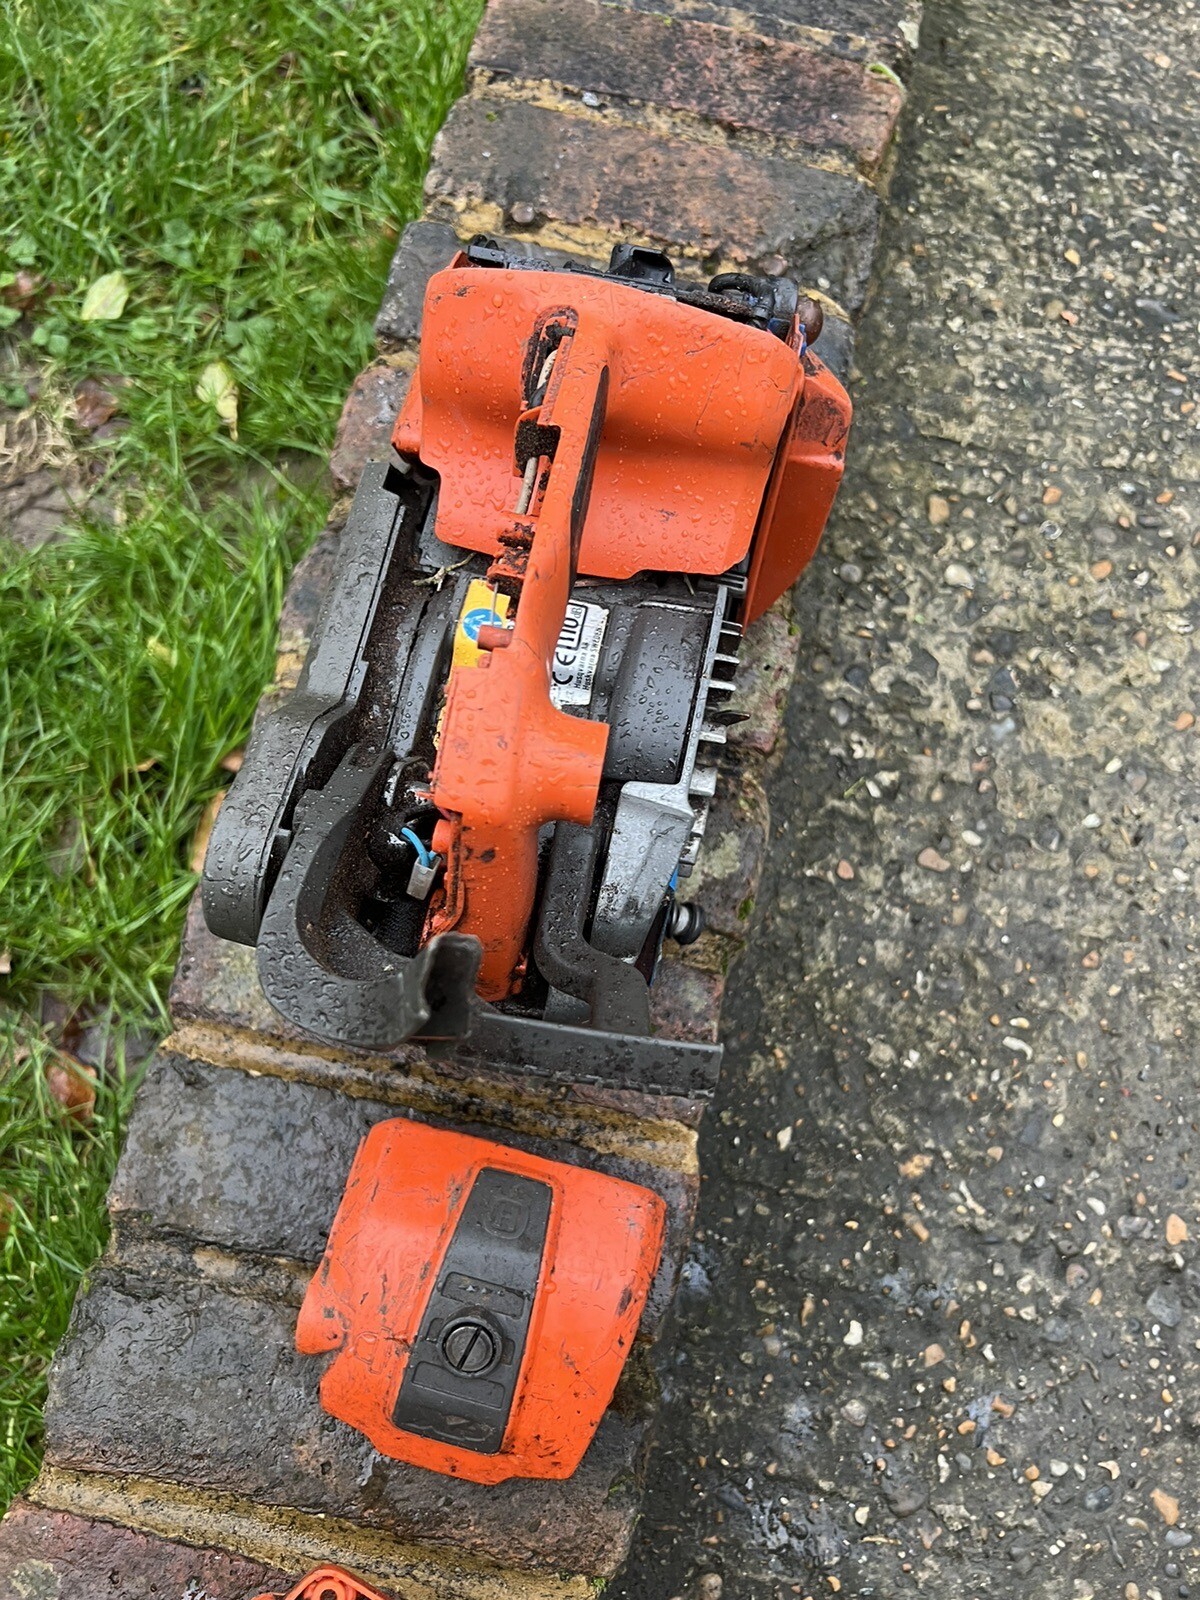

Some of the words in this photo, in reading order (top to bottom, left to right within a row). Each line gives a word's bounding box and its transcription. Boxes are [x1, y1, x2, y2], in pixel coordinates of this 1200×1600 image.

[552, 652, 577, 685] CE
[574, 653, 588, 689] Husqvarna
[582, 654, 596, 690] Huskvarna
